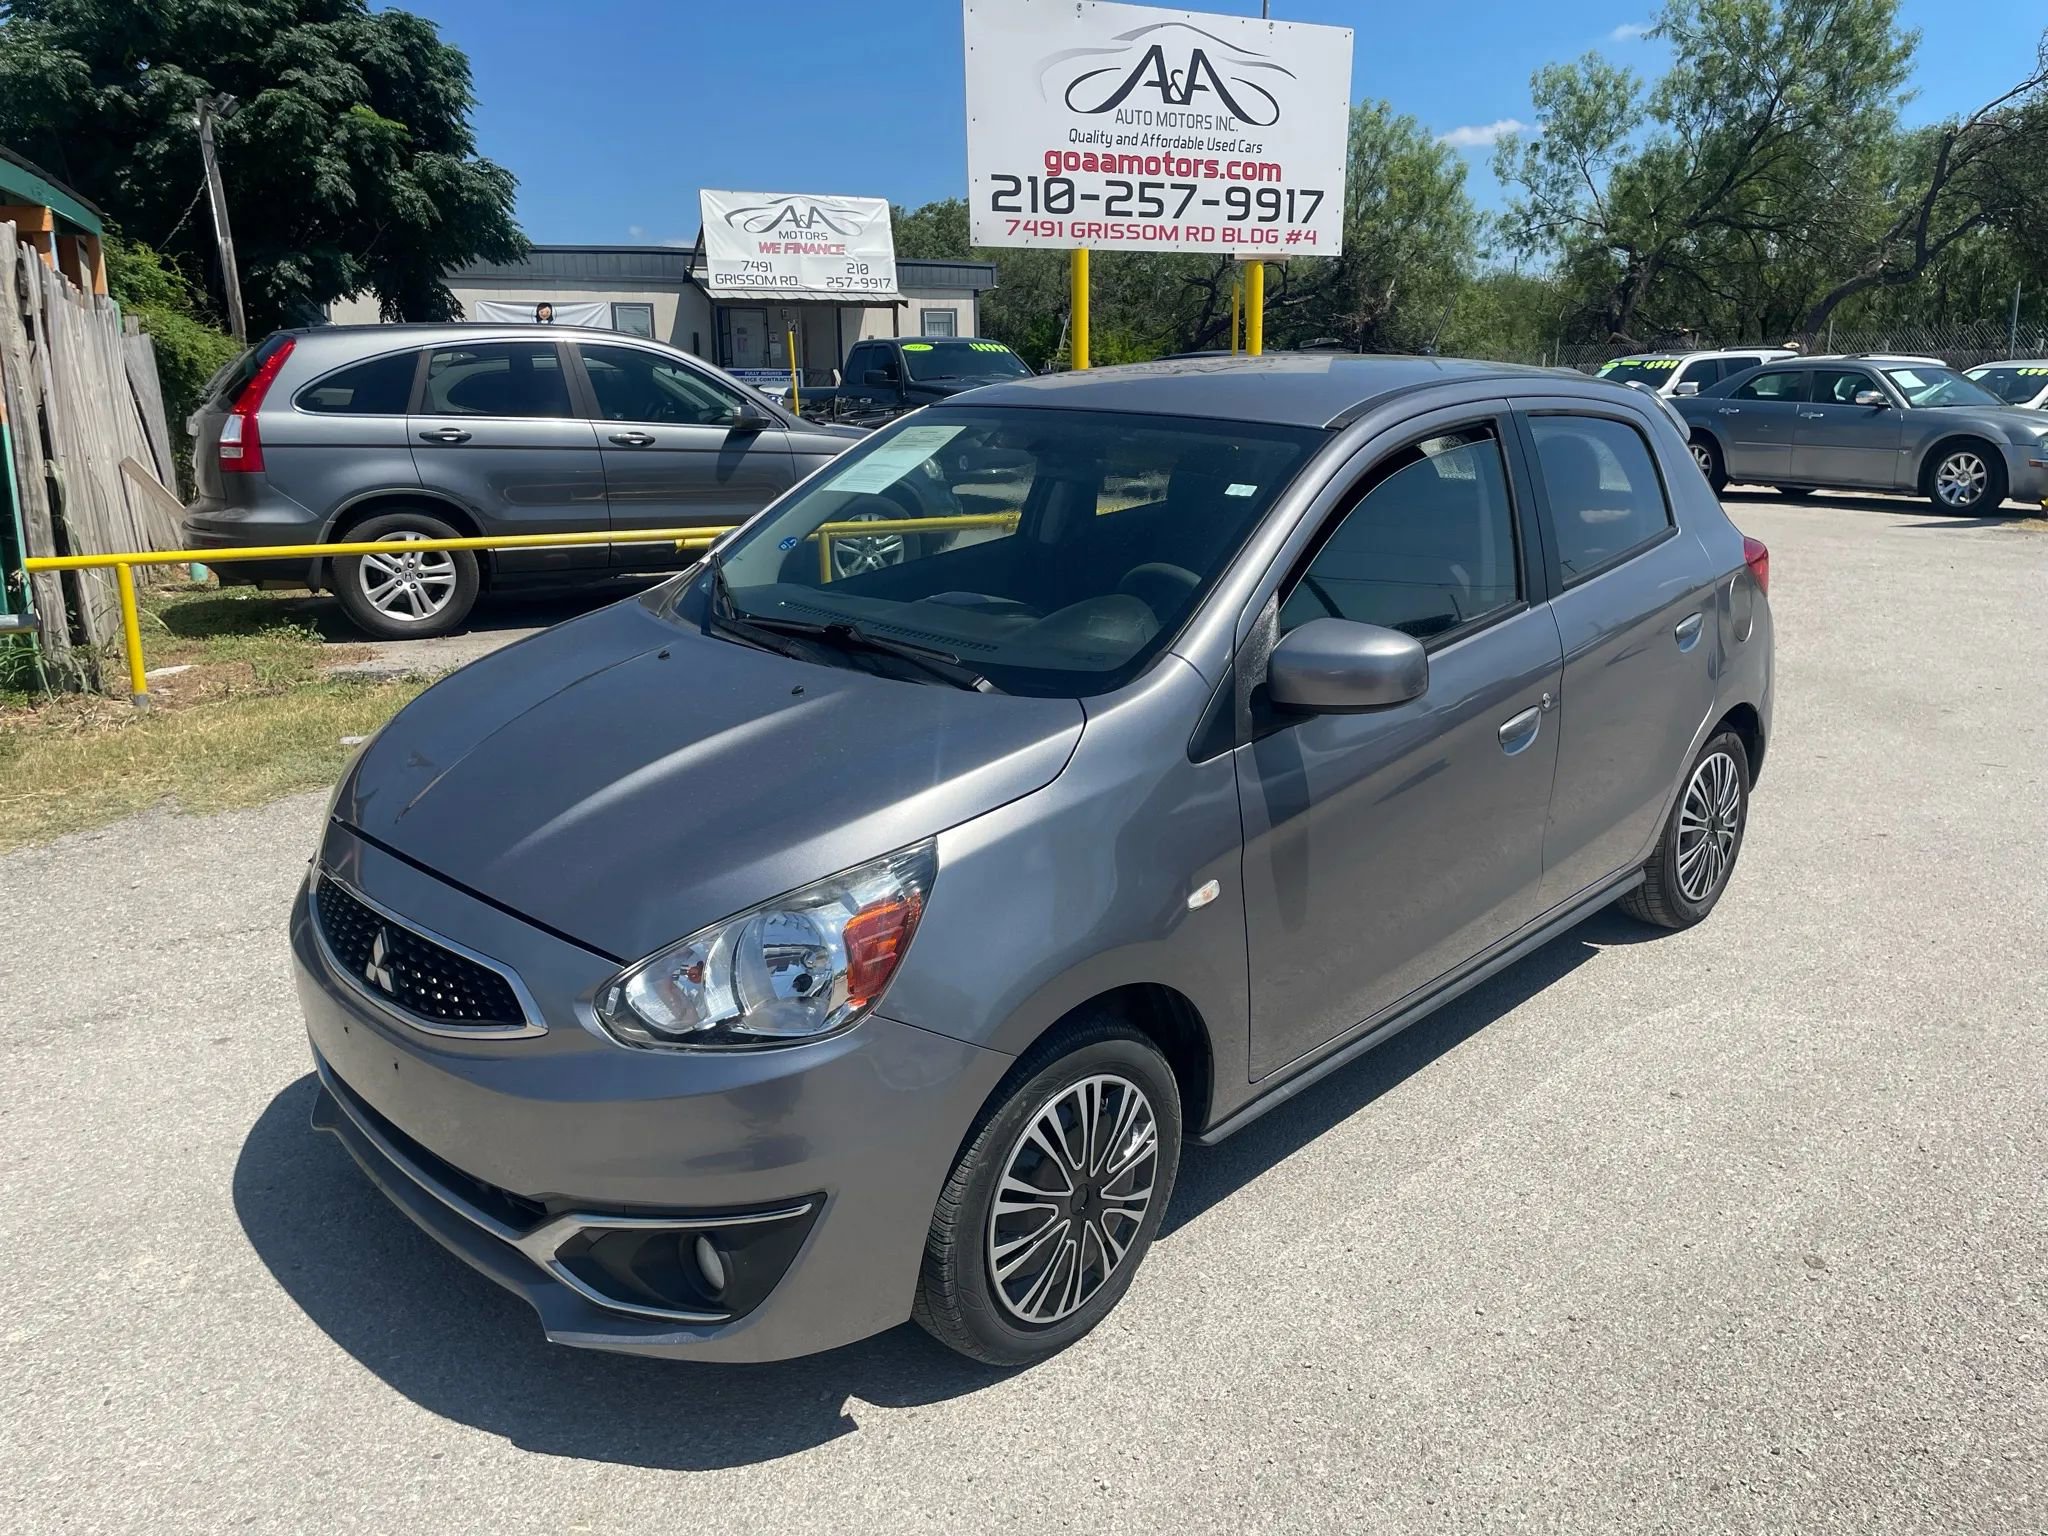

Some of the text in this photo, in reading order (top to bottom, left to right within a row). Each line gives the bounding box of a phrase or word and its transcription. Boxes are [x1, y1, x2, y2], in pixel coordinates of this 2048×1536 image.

[1065, 44, 1280, 126] A&A
[1115, 109, 1239, 132] AUTO MOTORS INC.
[1068, 128, 1263, 154] Quality and Affordable Used Cars
[1044, 148, 1282, 182] goaamotors.com
[990, 174, 1325, 224] 210-257-9917
[778, 230, 829, 241] MOTORS
[1005, 219, 1317, 245] 7491 GRISSOM RD BLDG #4
[758, 241, 846, 256] WE FINANCE
[741, 260, 773, 273] 7491
[846, 262, 869, 275] 210
[715, 273, 798, 287] GRISSOM RD
[826, 276, 891, 289] 257-9917
